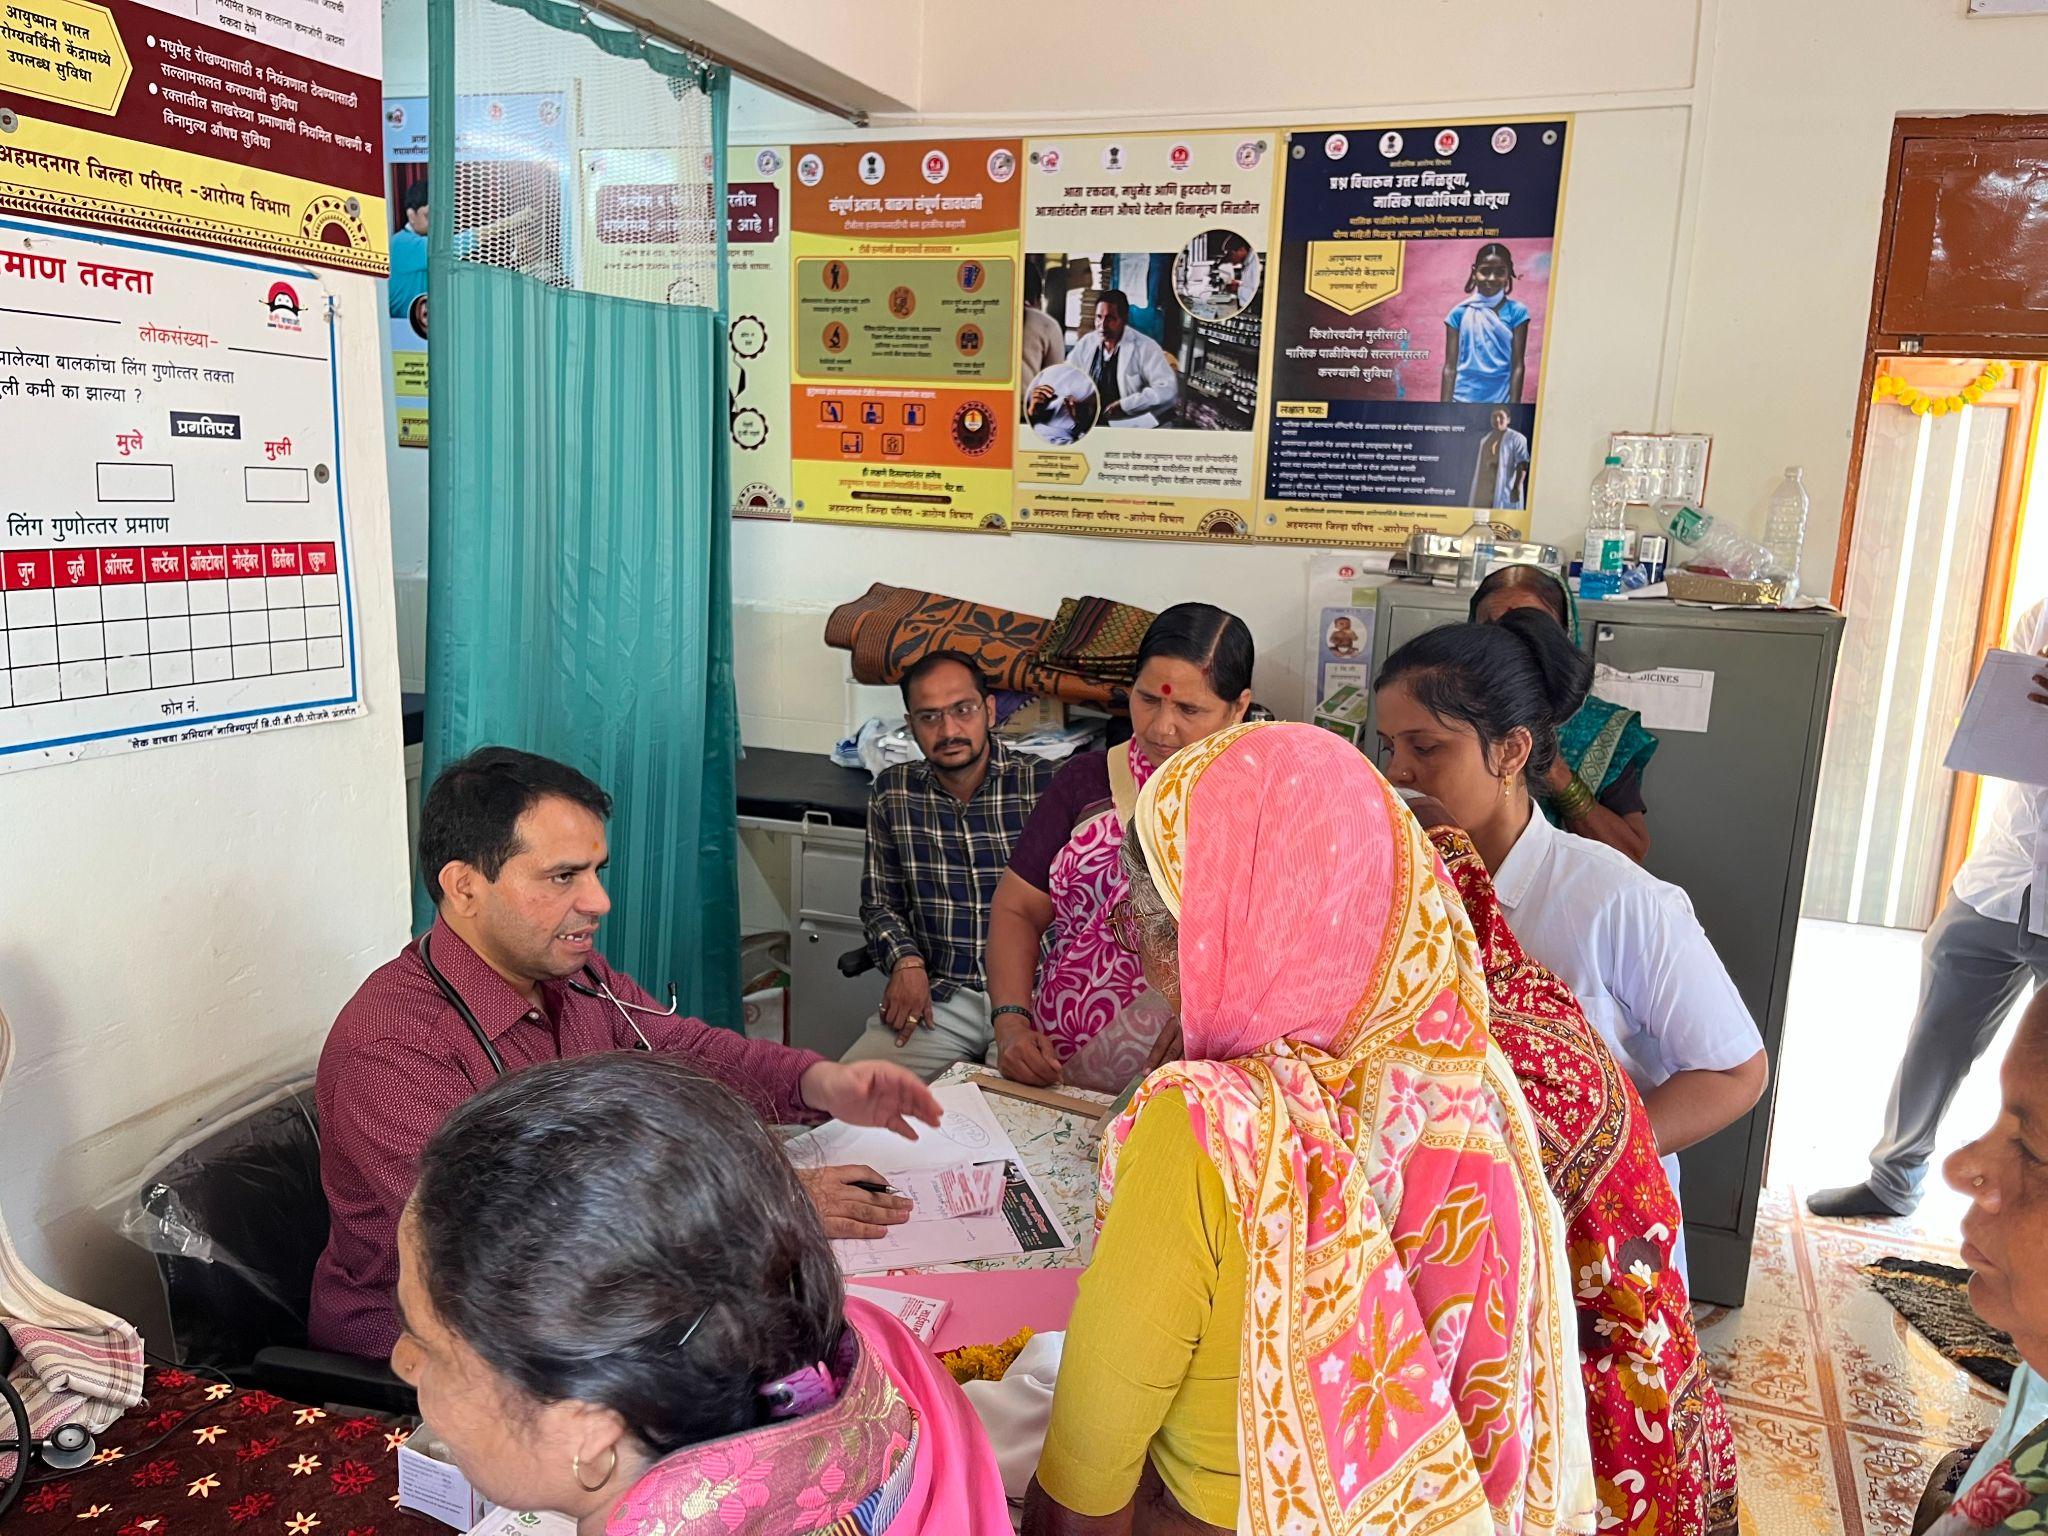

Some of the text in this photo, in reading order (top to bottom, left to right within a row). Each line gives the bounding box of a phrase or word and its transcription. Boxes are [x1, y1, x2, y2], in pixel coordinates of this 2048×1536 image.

[6, 5, 90, 40] आयुष्मान भारत
[7, 49, 92, 83] उपलब्ध सुविधा
[65, 40, 112, 67] केंद्रामध्ये
[159, 38, 358, 109] मधुमेह रोखण्यासाठी व नियंत्रणात ठेवण्यासाठी
[161, 62, 298, 112] सल्लामसलत करण्याची सुविधा
[162, 86, 207, 111] रक्तातील
[211, 99, 254, 123] साखरेच्या
[258, 112, 296, 134] प्रमाणाची
[299, 120, 332, 144] नियमित
[364, 141, 373, 155] व
[163, 109, 271, 150] विनामुल्य औषध सुविधा
[0, 145, 291, 219] अहमदनगर जिल्हा परिषद -आरोग्य विभाग
[1064, 186, 1083, 198] आता
[1086, 186, 1119, 199] रक्तदाब,
[1121, 182, 1151, 200] मधुमेह
[1154, 182, 1178, 196] आणि
[1220, 183, 1231, 195] या
[1090, 204, 1114, 216] महाग
[1116, 202, 1142, 216] औषधे
[1143, 201, 1172, 216] देखील
[1220, 201, 1260, 215] मिळतील
[1373, 192, 1412, 209] मासिक
[737, 213, 774, 233] आहे !
[0, 250, 154, 296] माण तक्ता
[138, 322, 219, 350] लोकसंख्या-
[1285, 345, 1317, 359] मासिक
[1370, 349, 1429, 360] सल्लामसलत
[56, 354, 116, 375] बालकांचा
[122, 354, 147, 377] लिंग
[152, 357, 198, 382] गुणोत्तर
[203, 368, 235, 384] तक्ता
[1318, 365, 1393, 382] करण्याची सुविधा
[0, 375, 143, 404] ली कमी का झाल्या ?
[176, 415, 236, 438] प्रगतिपर
[115, 429, 144, 455] मुले
[264, 437, 292, 461] मुली
[866, 503, 888, 515] जिल्हा
[891, 506, 913, 517] परिषद
[949, 508, 974, 519] विभाग
[1071, 507, 1094, 520] जिल्हा
[1097, 510, 1120, 521] परिषद
[1159, 512, 1185, 524] विभाग
[7, 511, 170, 542] लिंग गुणोत्तर प्रमाण
[1325, 520, 1349, 531] जिल्हा
[1351, 522, 1374, 533] परिषद
[17, 560, 36, 587] जुन
[67, 553, 86, 585] जुलै
[104, 551, 135, 576] ऑगस्ट
[161, 696, 199, 716] फोन नं.
